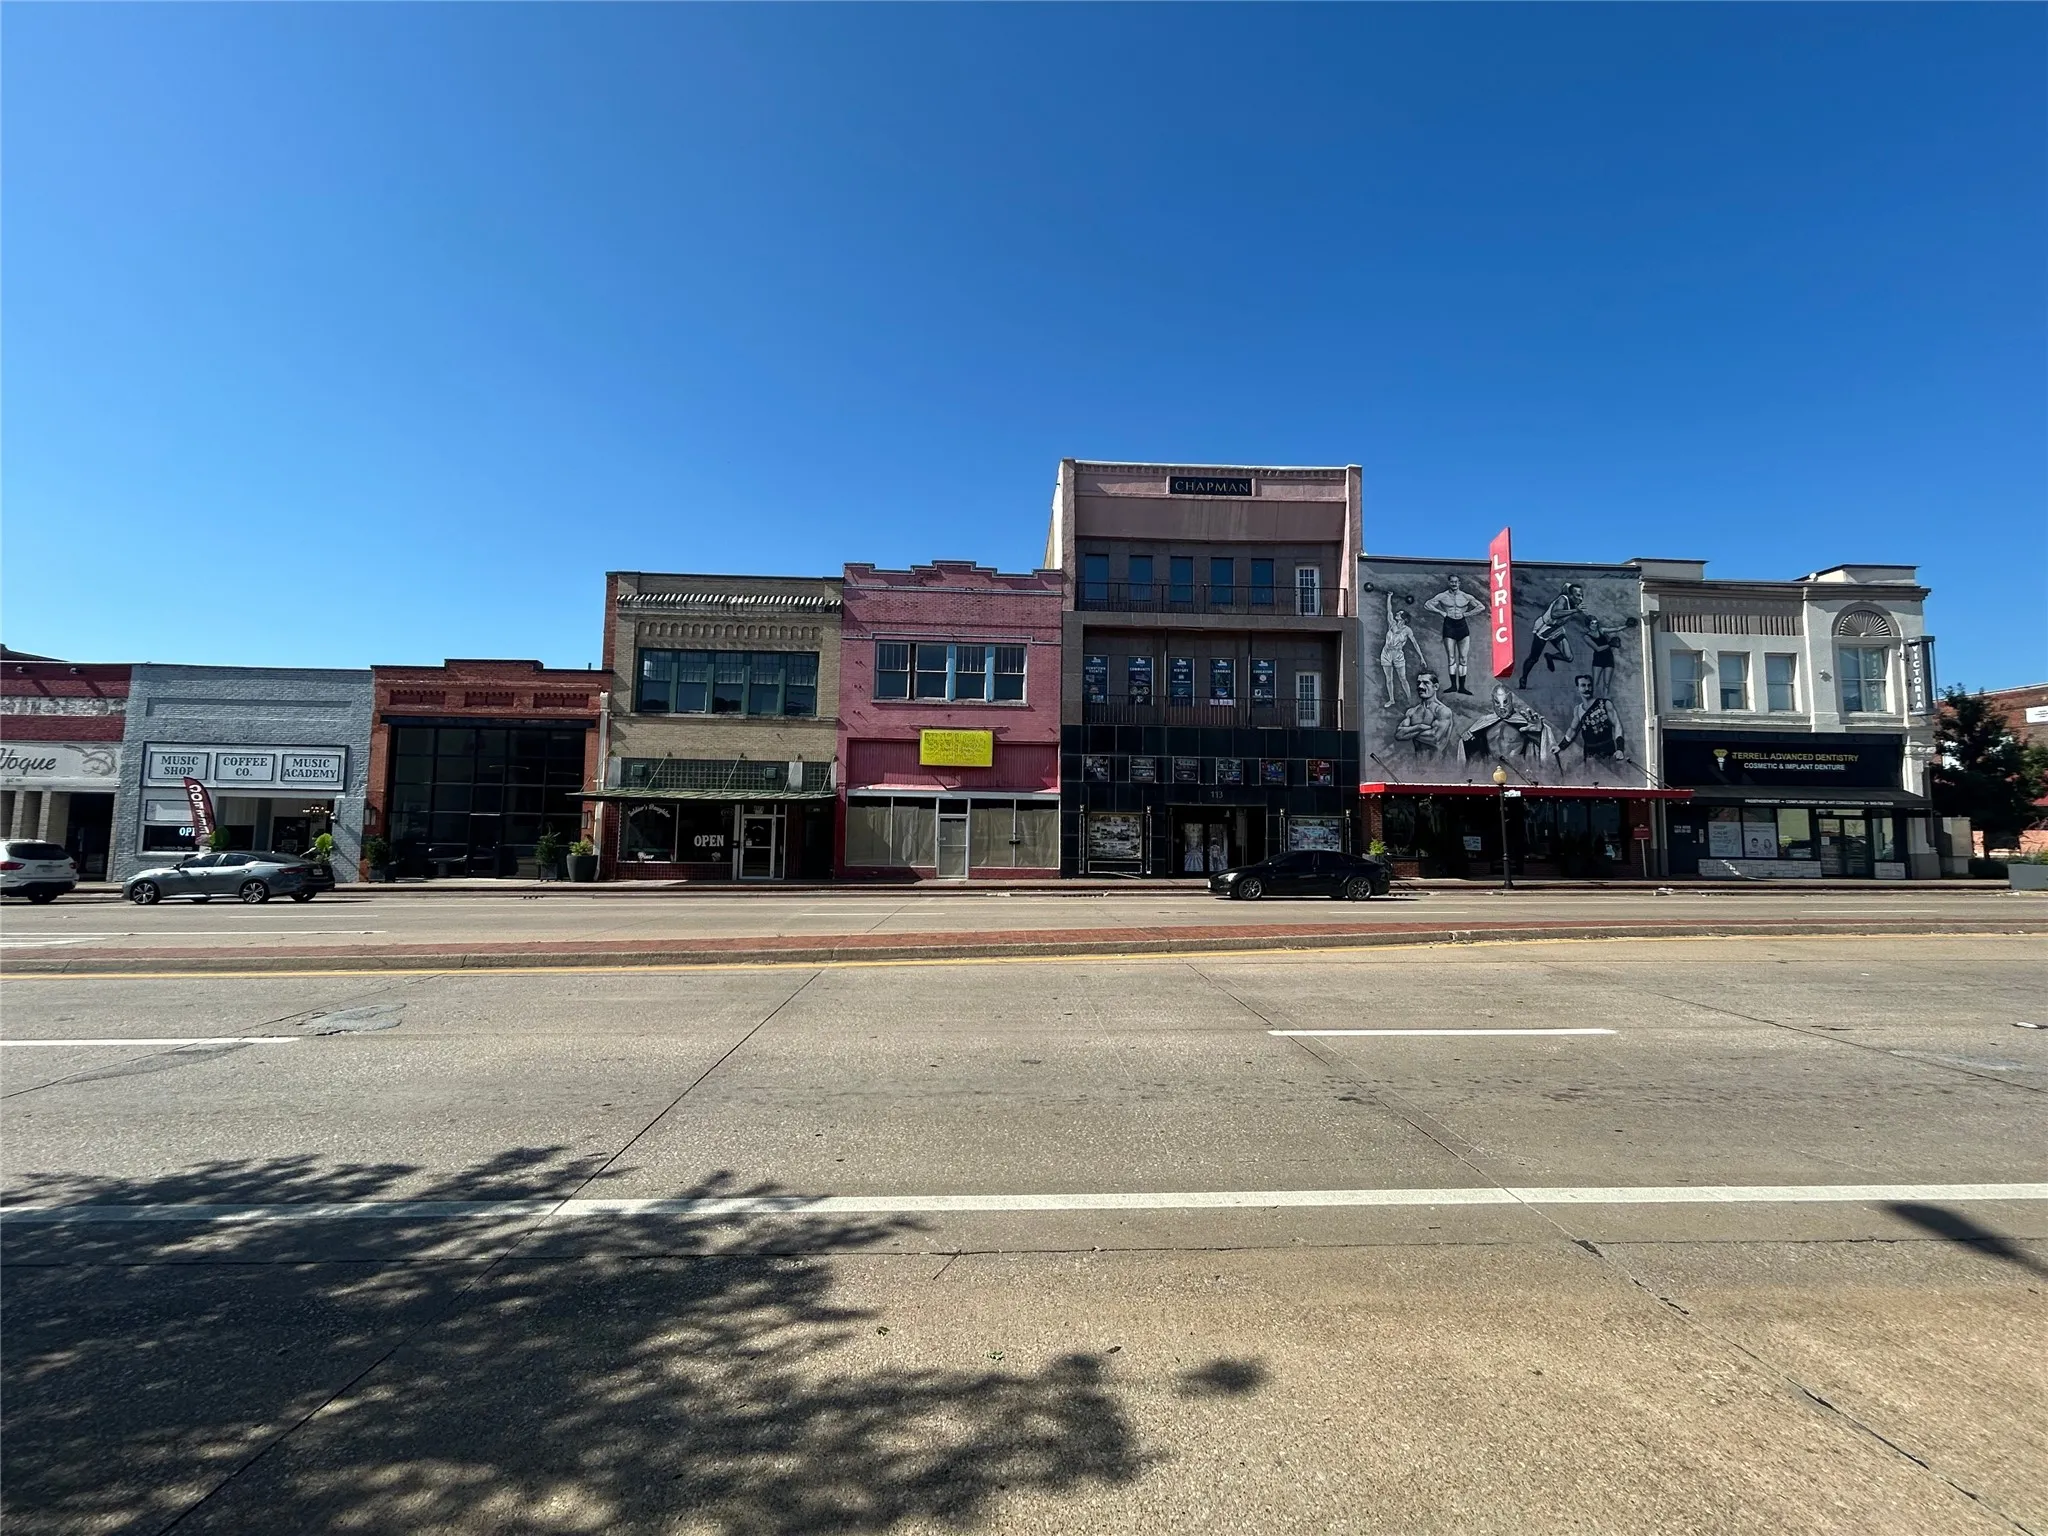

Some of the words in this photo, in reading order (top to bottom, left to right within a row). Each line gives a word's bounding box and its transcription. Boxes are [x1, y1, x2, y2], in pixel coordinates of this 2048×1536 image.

[1175, 481, 1249, 493] CHAPMAN
[1493, 554, 1508, 643] LYRIC
[1911, 645, 1923, 709] VICTORIA
[160, 755, 199, 765] MUSIC
[222, 756, 268, 766] COFFEE
[1732, 752, 1769, 760] TERRELL
[1770, 752, 1814, 761] ADVANCED
[1815, 753, 1859, 762] DENTISTRY
[292, 758, 330, 768] MUSIC
[1814, 763, 1846, 771] DENTURE
[163, 766, 194, 775] SHOP
[235, 767, 253, 777] CO.
[283, 768, 337, 778] ACADEMY
[188, 784, 210, 834] COFFEE
[693, 835, 725, 847] OPEN
